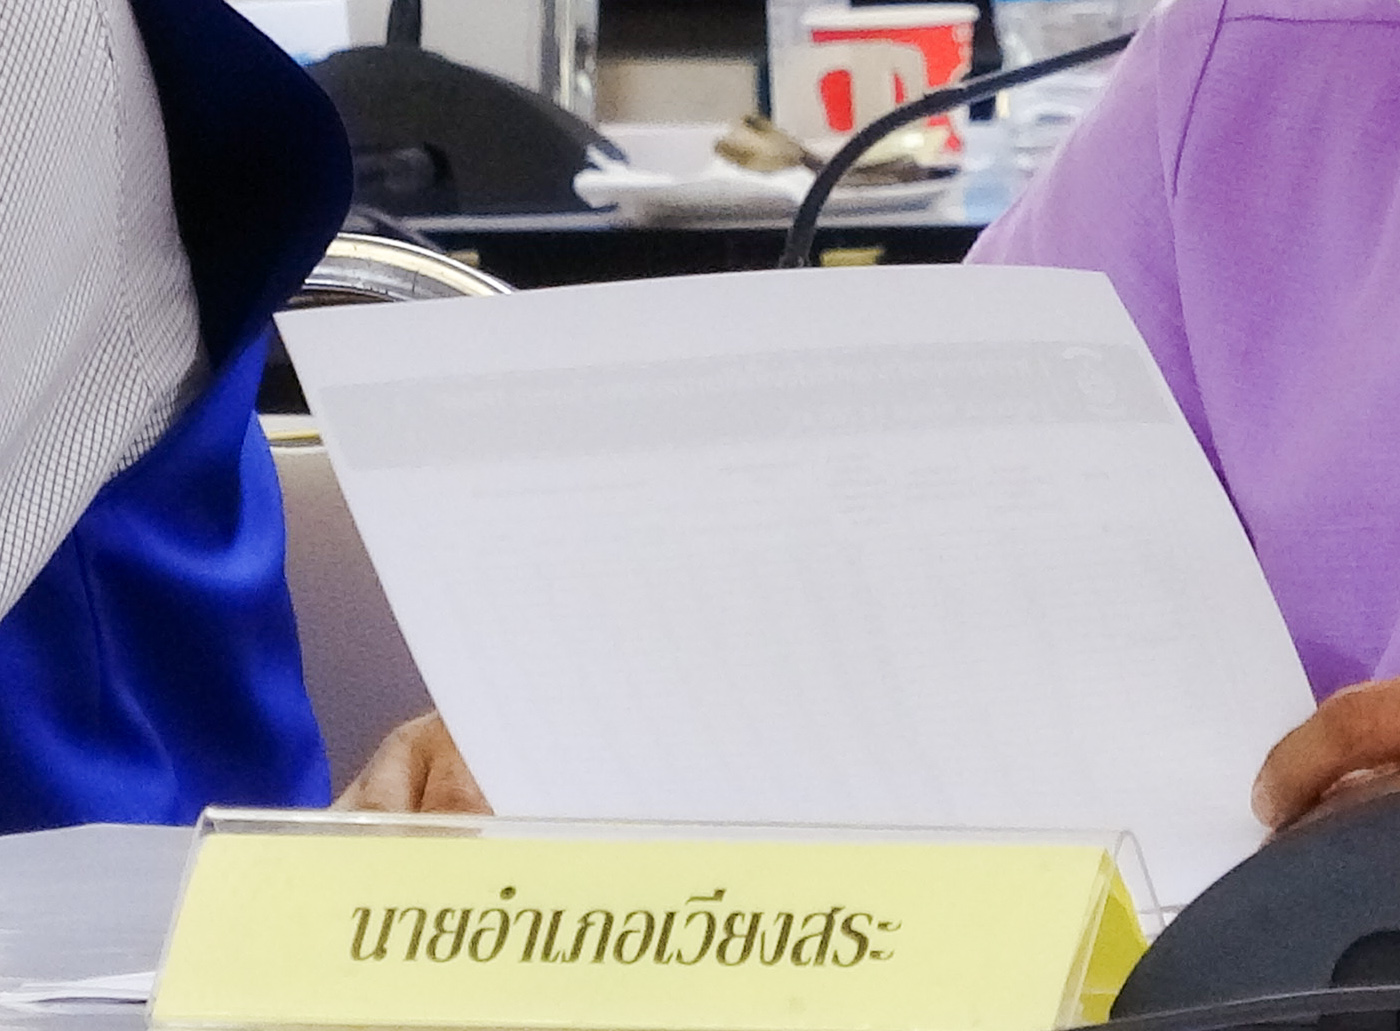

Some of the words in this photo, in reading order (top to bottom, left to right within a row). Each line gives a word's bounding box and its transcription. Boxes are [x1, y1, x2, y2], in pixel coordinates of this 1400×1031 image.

[349, 885, 903, 968] นายอำเภอเวียงสระ
